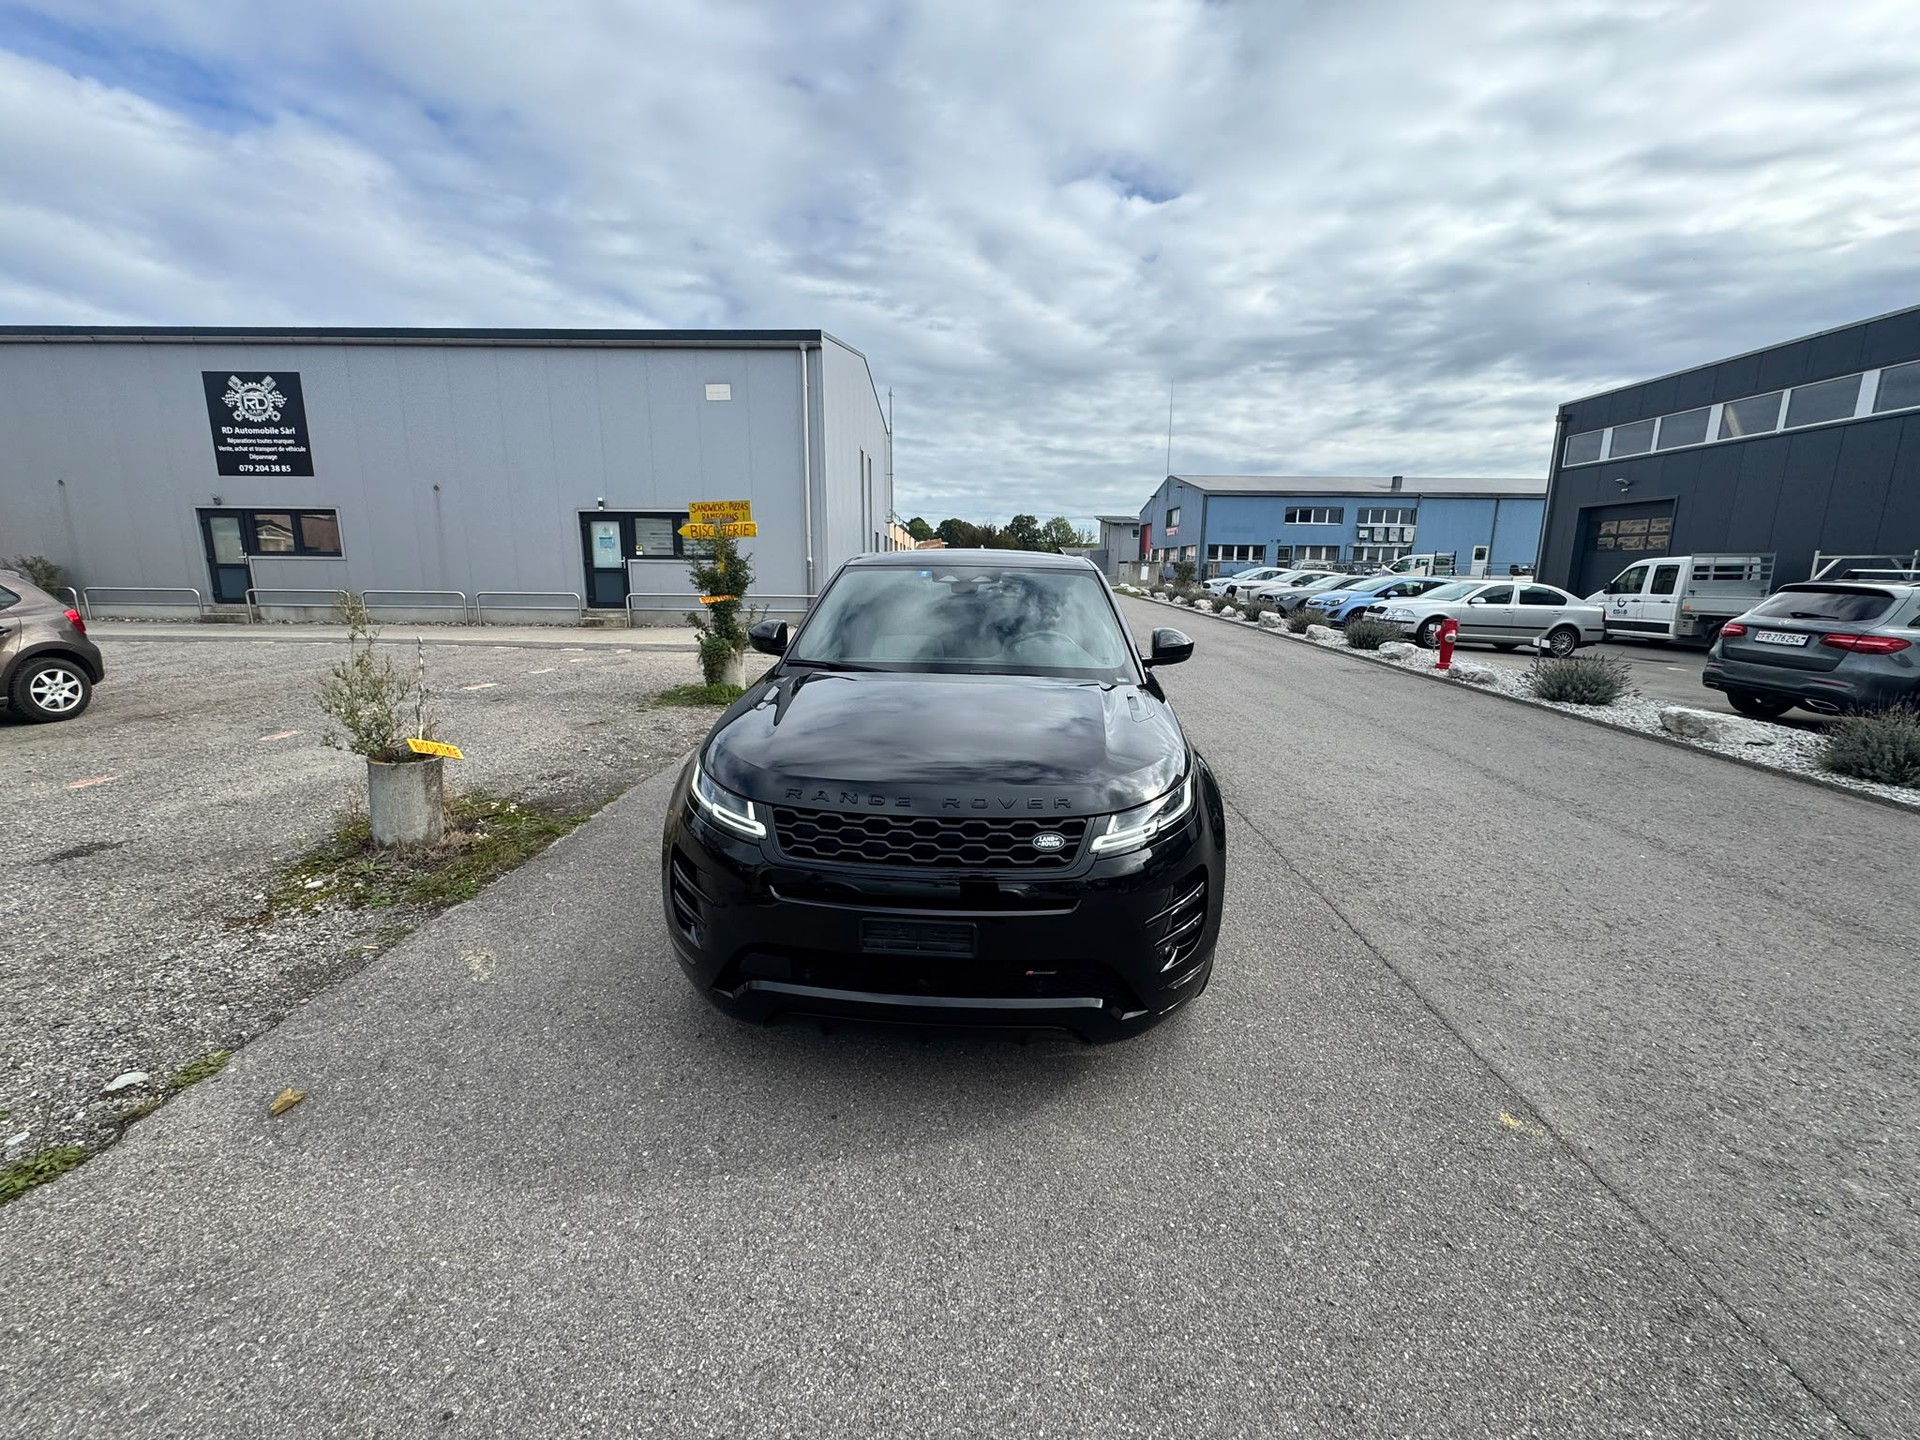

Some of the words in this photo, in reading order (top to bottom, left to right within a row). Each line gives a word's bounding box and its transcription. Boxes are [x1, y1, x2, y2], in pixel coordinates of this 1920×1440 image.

[238, 464, 254, 472] 079
[270, 464, 280, 472] 38
[281, 464, 291, 472] 85
[729, 502, 749, 511] PIZZAS
[690, 523, 751, 538] BISCTERIE
[785, 787, 912, 808] RANGE
[942, 796, 1072, 810] ROVER
